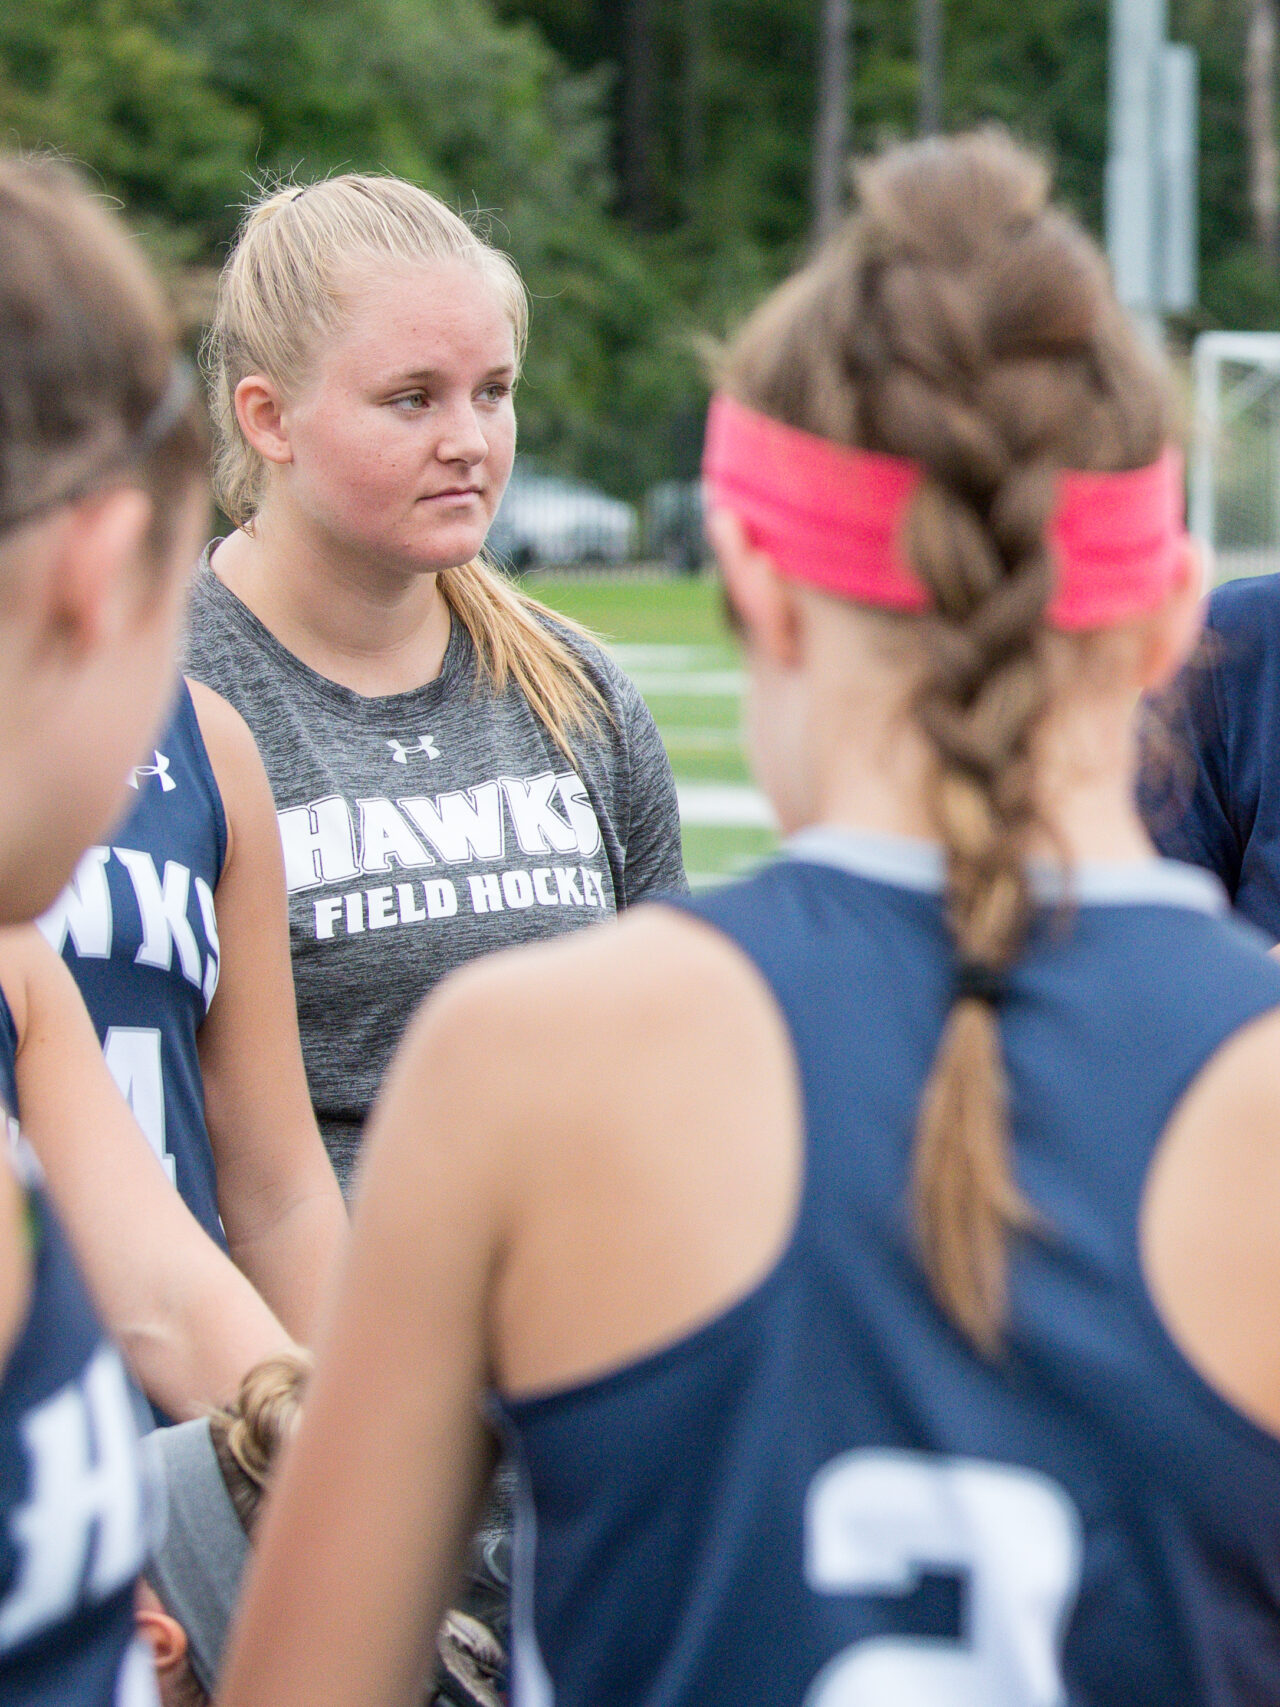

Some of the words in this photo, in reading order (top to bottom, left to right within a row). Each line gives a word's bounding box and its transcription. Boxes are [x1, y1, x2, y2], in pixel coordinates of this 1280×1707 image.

[277, 770, 602, 895] HAWKS
[34, 845, 221, 1015] WKS
[313, 878, 458, 940] FIELD
[466, 866, 608, 915] HOCKEY
